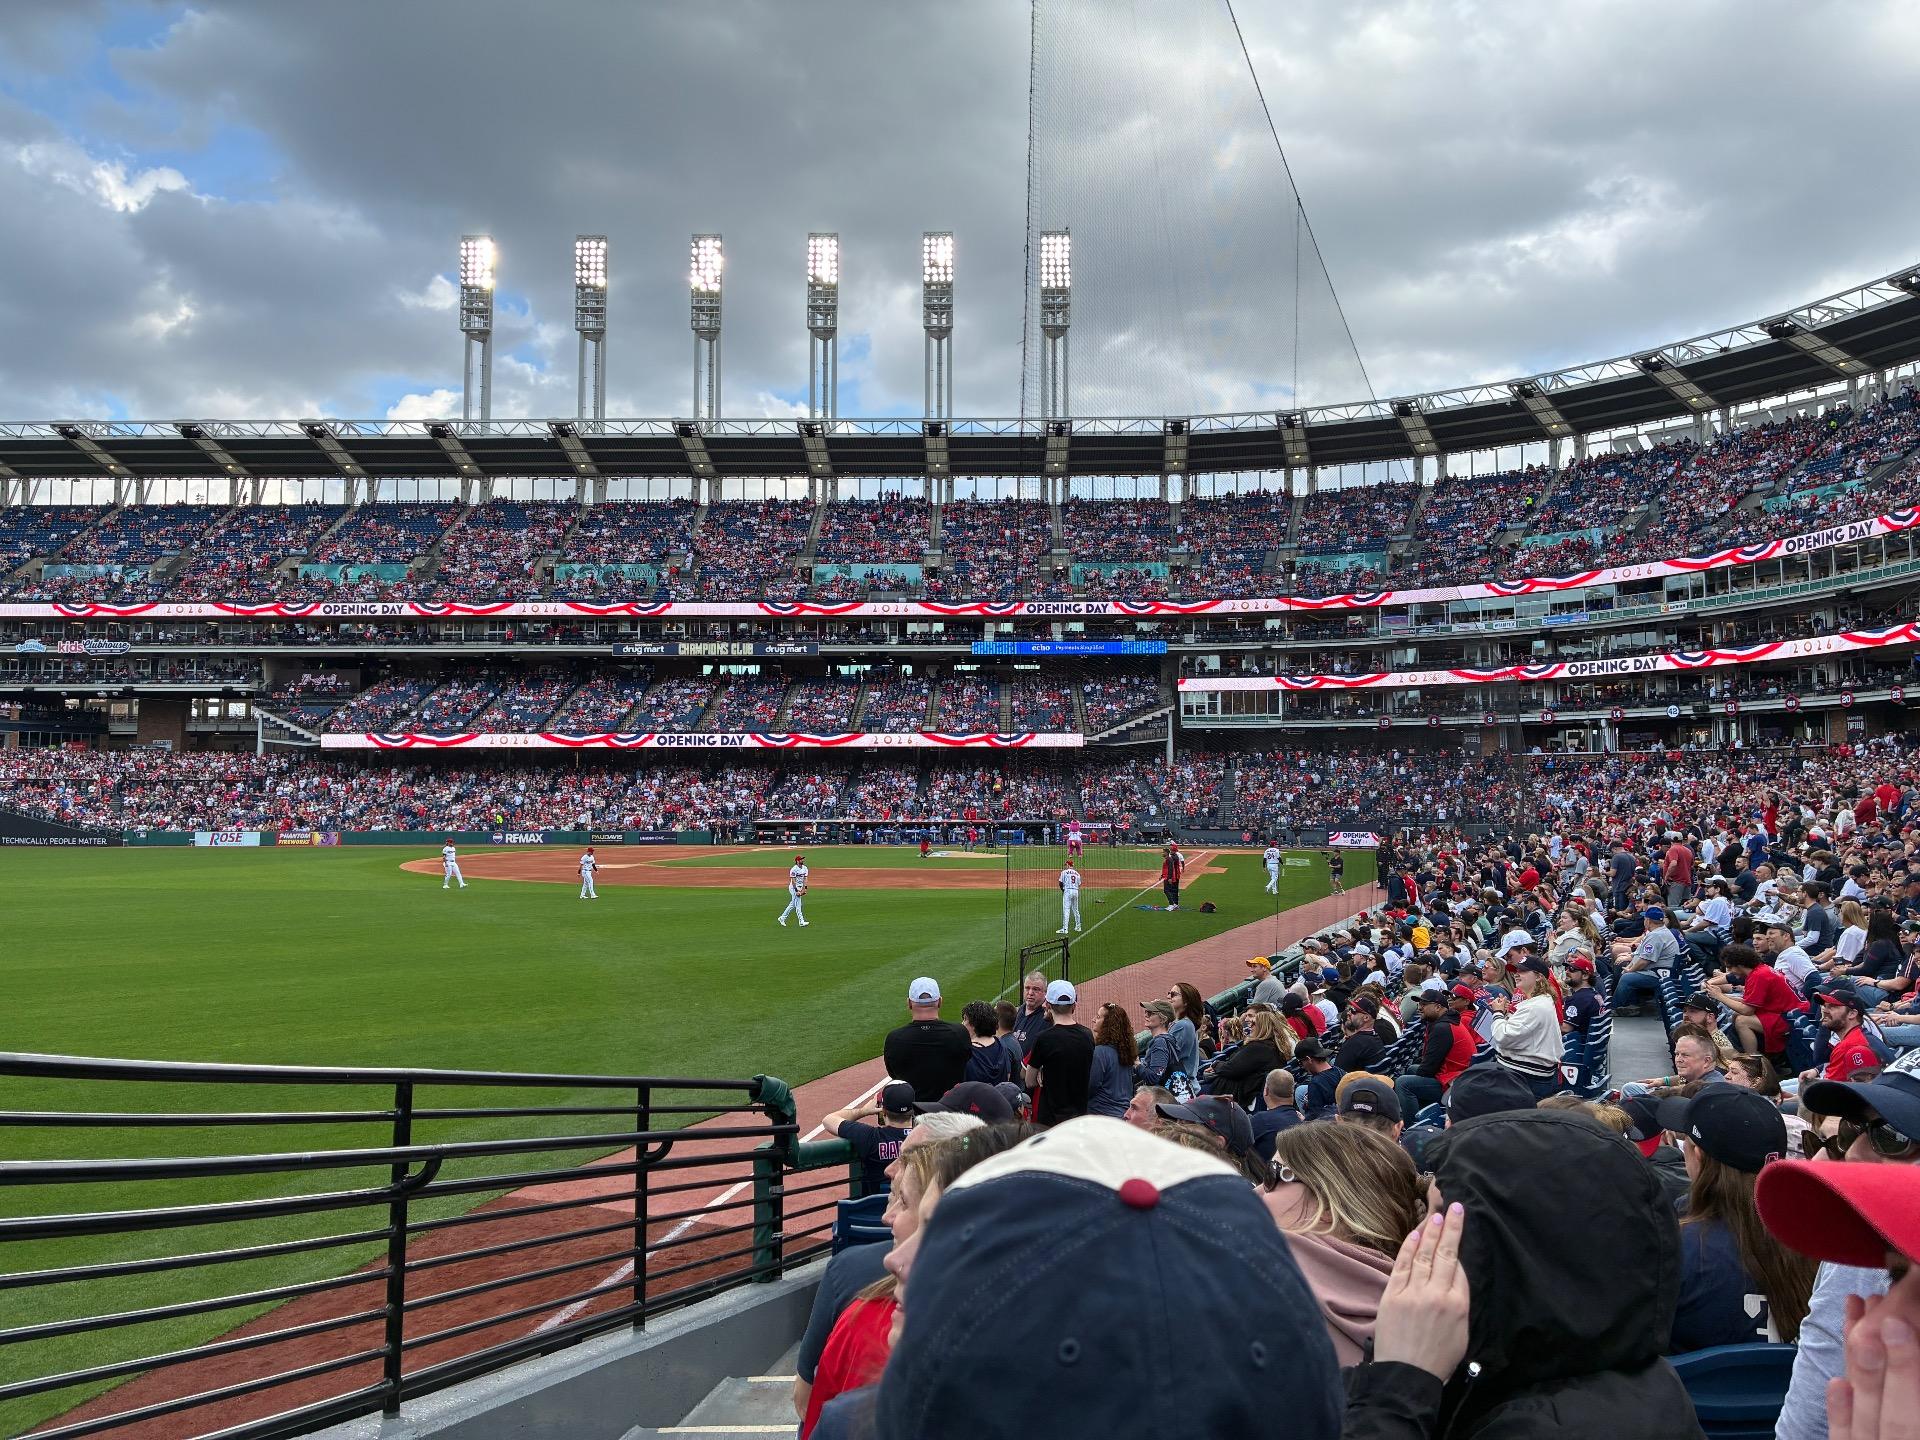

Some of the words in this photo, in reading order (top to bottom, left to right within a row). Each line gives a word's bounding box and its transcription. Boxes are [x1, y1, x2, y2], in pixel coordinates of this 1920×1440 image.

[1785, 528, 1844, 553] OPENING
[1848, 520, 1873, 542] DAY
[1612, 565, 1652, 579] 2026
[166, 605, 203, 614] 2026
[322, 604, 378, 615] OPENING
[381, 604, 404, 615] DAY
[521, 604, 559, 613] 2026
[872, 604, 909, 613] 2026
[1027, 603, 1083, 614] OPENING
[1086, 603, 1109, 614] DAY
[1231, 601, 1269, 610] 2026
[58, 640, 84, 653] kids
[83, 638, 129, 650] Clubhouse
[622, 644, 643, 654] drug
[644, 645, 665, 653] mart
[678, 643, 728, 656] CHAMPIONS
[731, 643, 754, 656] CLUB
[765, 644, 786, 654] drug
[786, 645, 808, 653] mart
[1793, 639, 1833, 654] 2026
[1568, 660, 1631, 676] OPENING
[1634, 656, 1659, 672] DAY
[1399, 673, 1438, 684] 2026
[1841, 695, 1851, 703] 20
[489, 736, 529, 745] 2026
[656, 735, 717, 747] OPENING
[720, 735, 746, 747] DAY
[873, 736, 913, 745] 2026
[2, 837, 48, 845] TECHNICALLY,
[50, 837, 76, 845] PEOPLE
[209, 832, 243, 845] ROSE
[1071, 875, 1076, 884] 9
[1568, 1069, 1574, 1078] C
[879, 1141, 903, 1160] RA
